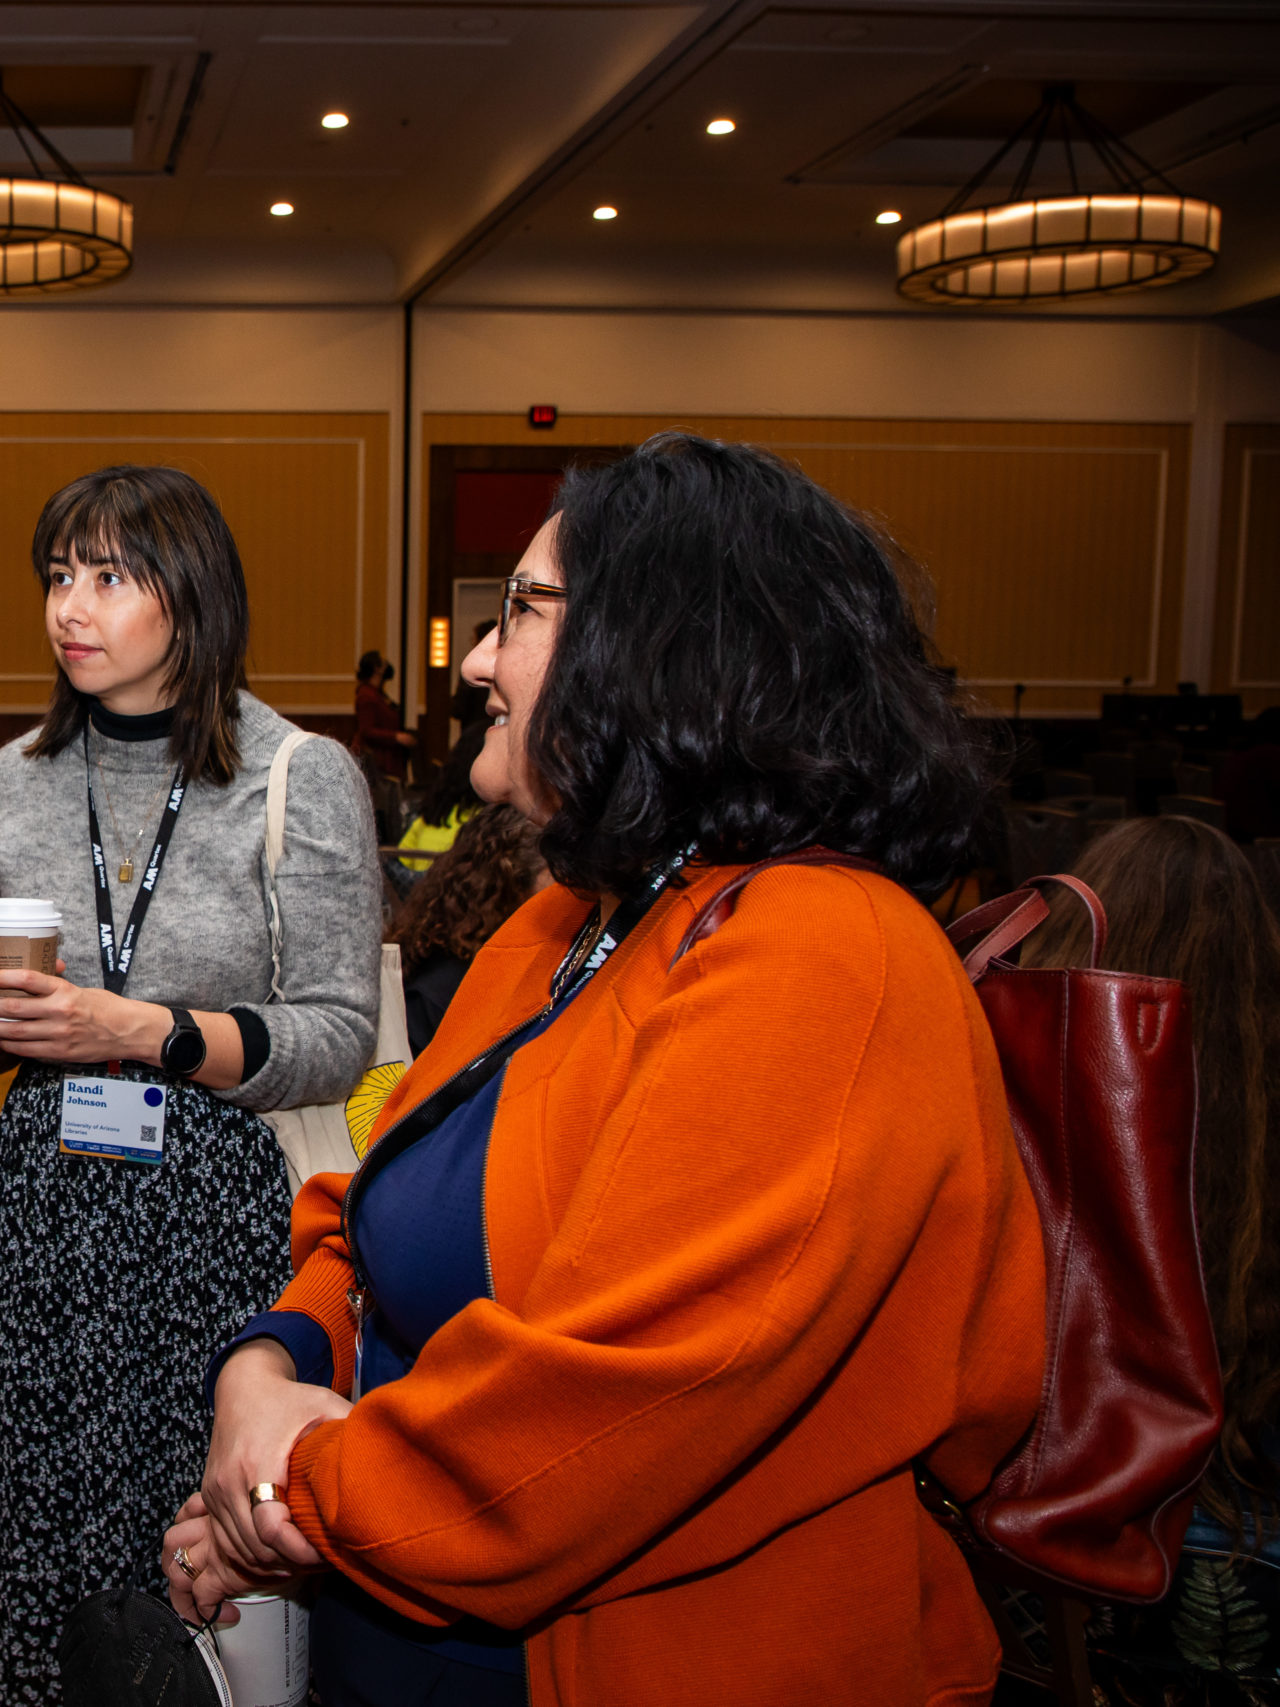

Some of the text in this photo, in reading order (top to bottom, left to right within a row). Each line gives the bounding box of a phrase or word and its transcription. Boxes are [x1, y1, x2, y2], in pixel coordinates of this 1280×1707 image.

[168, 788, 184, 812] AM
[93, 843, 104, 866] AM
[142, 867, 159, 891] AM
[100, 923, 113, 948] AM
[118, 948, 133, 974] AM
[584, 932, 618, 970] AM
[67, 1081, 104, 1096] Randi
[66, 1095, 107, 1108] Johnson
[64, 1121, 92, 1130] University
[100, 1125, 120, 1133] Arizona
[64, 1128, 88, 1136] Libraries
